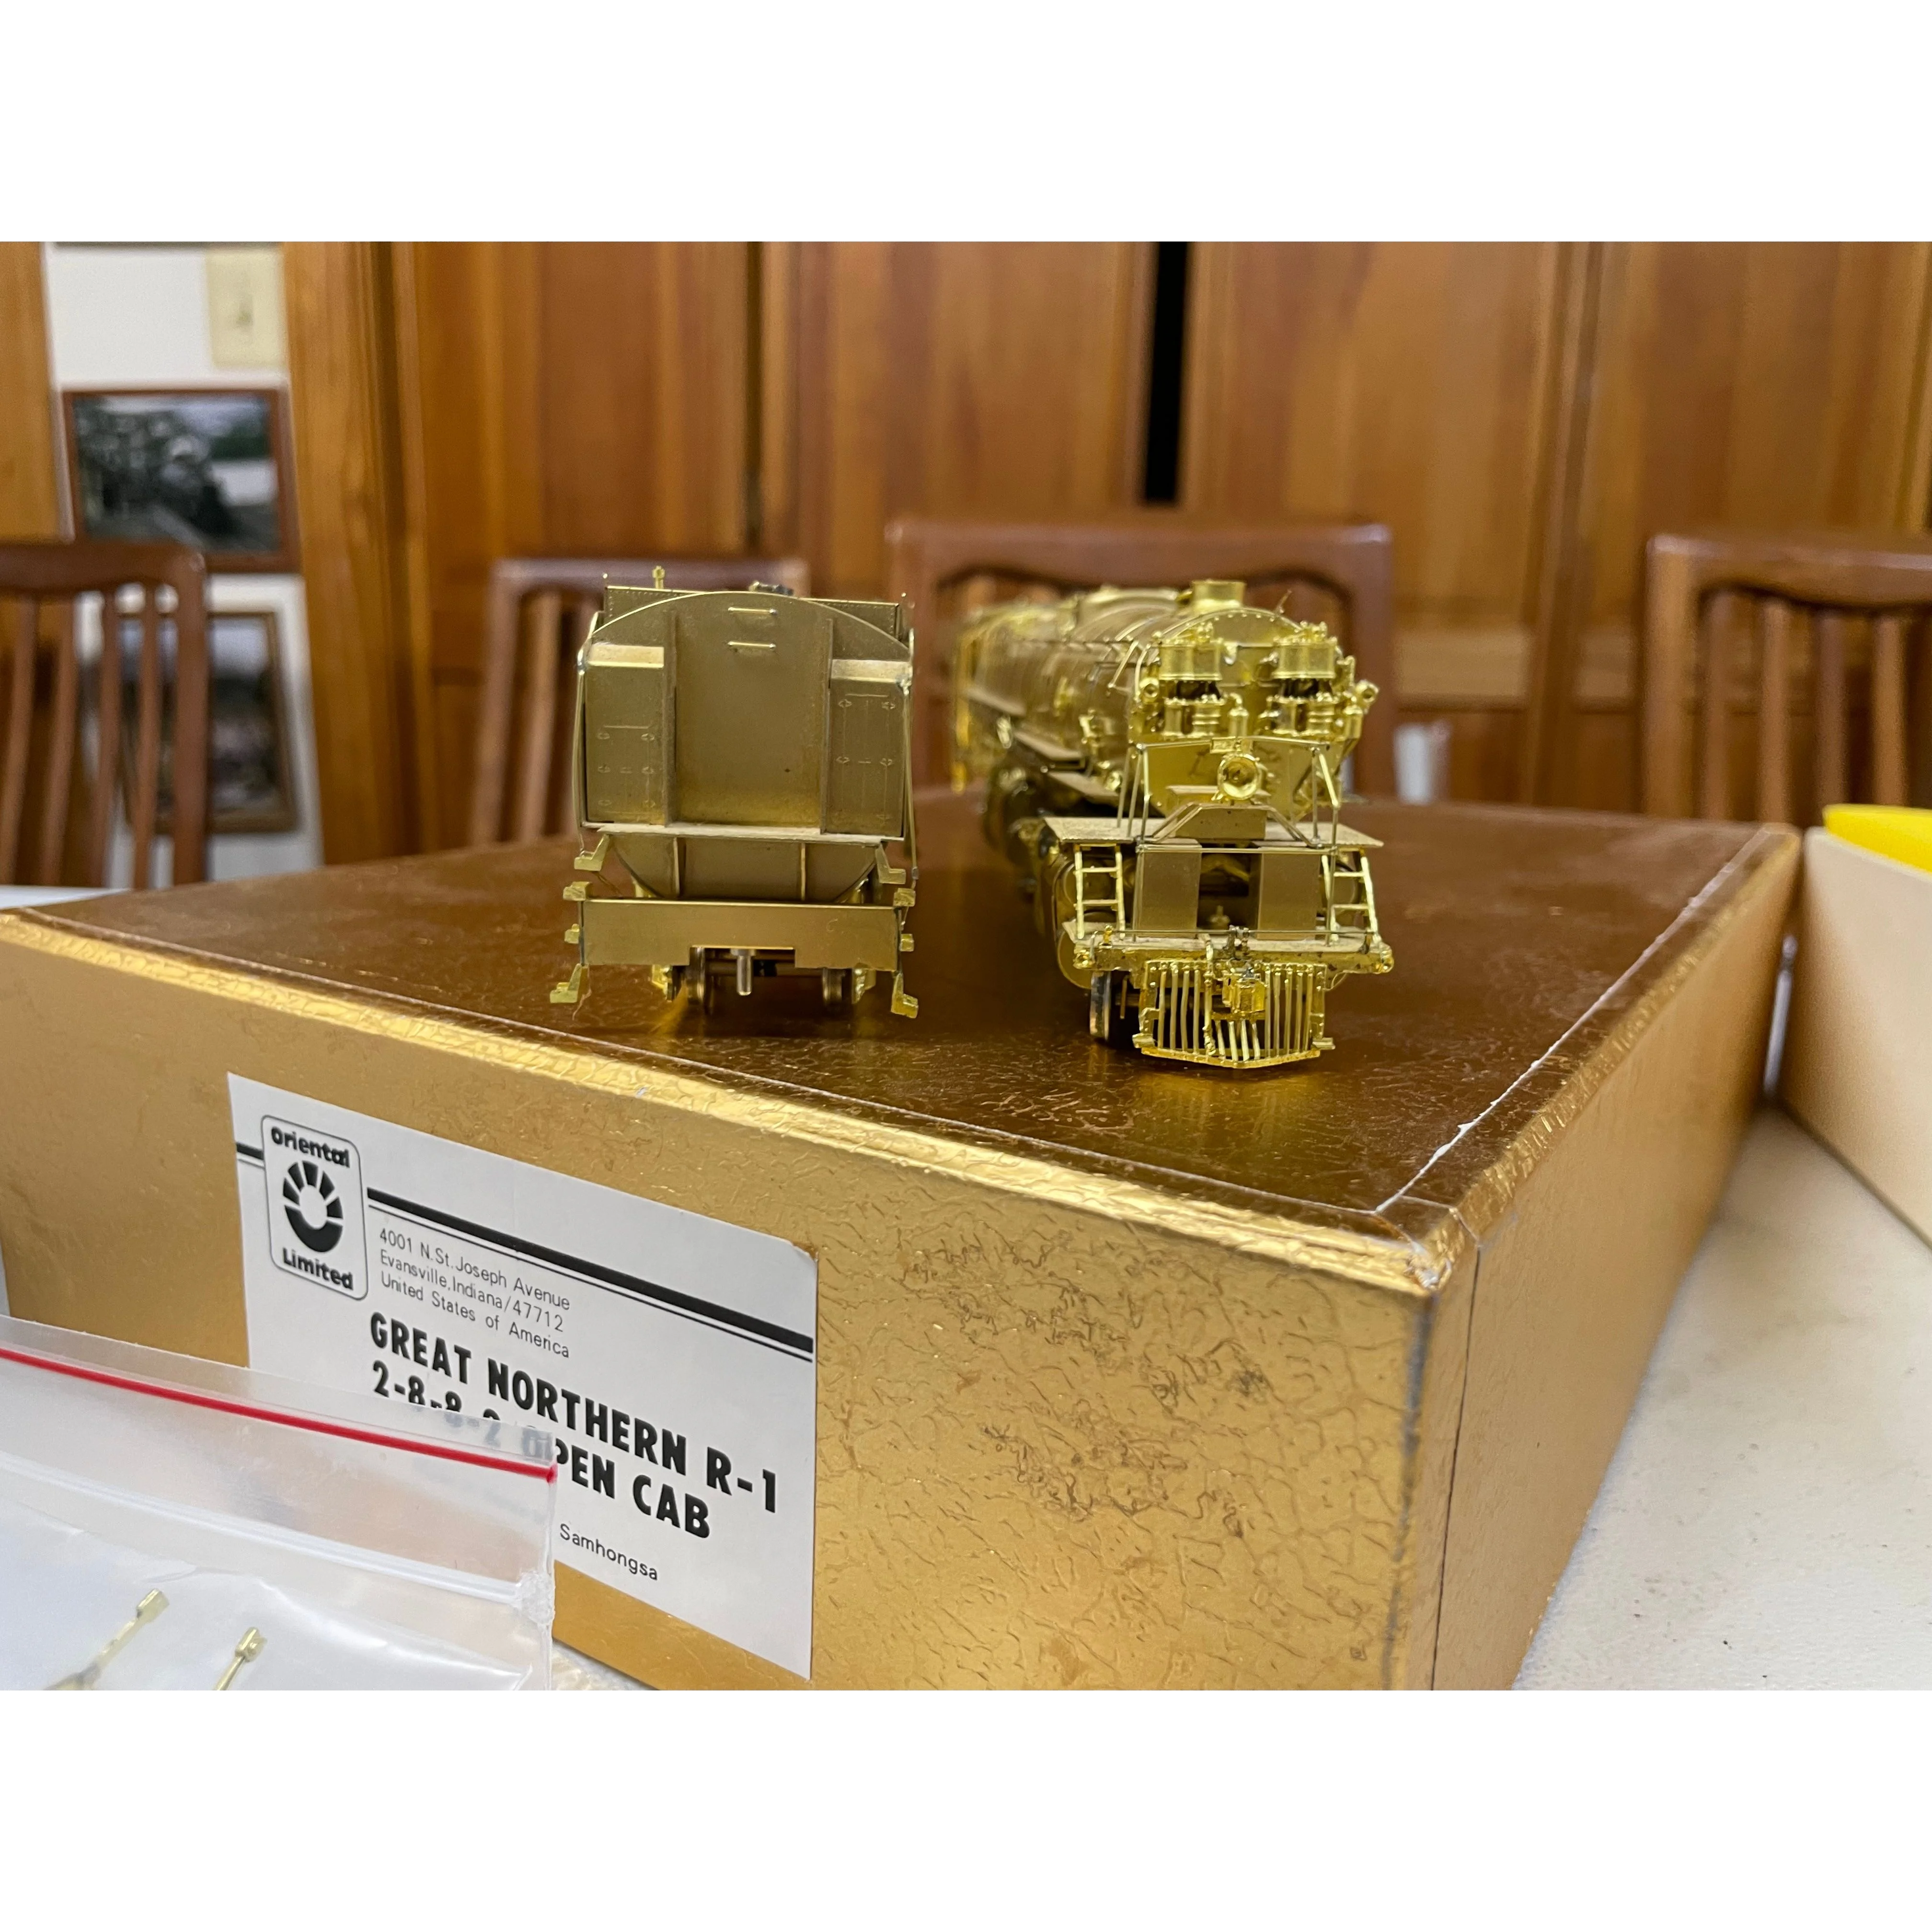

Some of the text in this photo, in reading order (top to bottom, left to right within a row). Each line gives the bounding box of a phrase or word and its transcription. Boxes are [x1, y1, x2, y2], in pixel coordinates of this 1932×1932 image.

[271, 1127, 350, 1168] Oriental
[283, 1247, 354, 1290] Limited
[380, 1228, 412, 1253] 4001
[513, 1277, 570, 1311] Avenue
[381, 1271, 569, 1358] United States of America
[370, 1311, 776, 1513] GREAT NORTHERN R-1
[632, 1474, 710, 1538] CAB
[560, 1523, 658, 1581] Samhongsa
